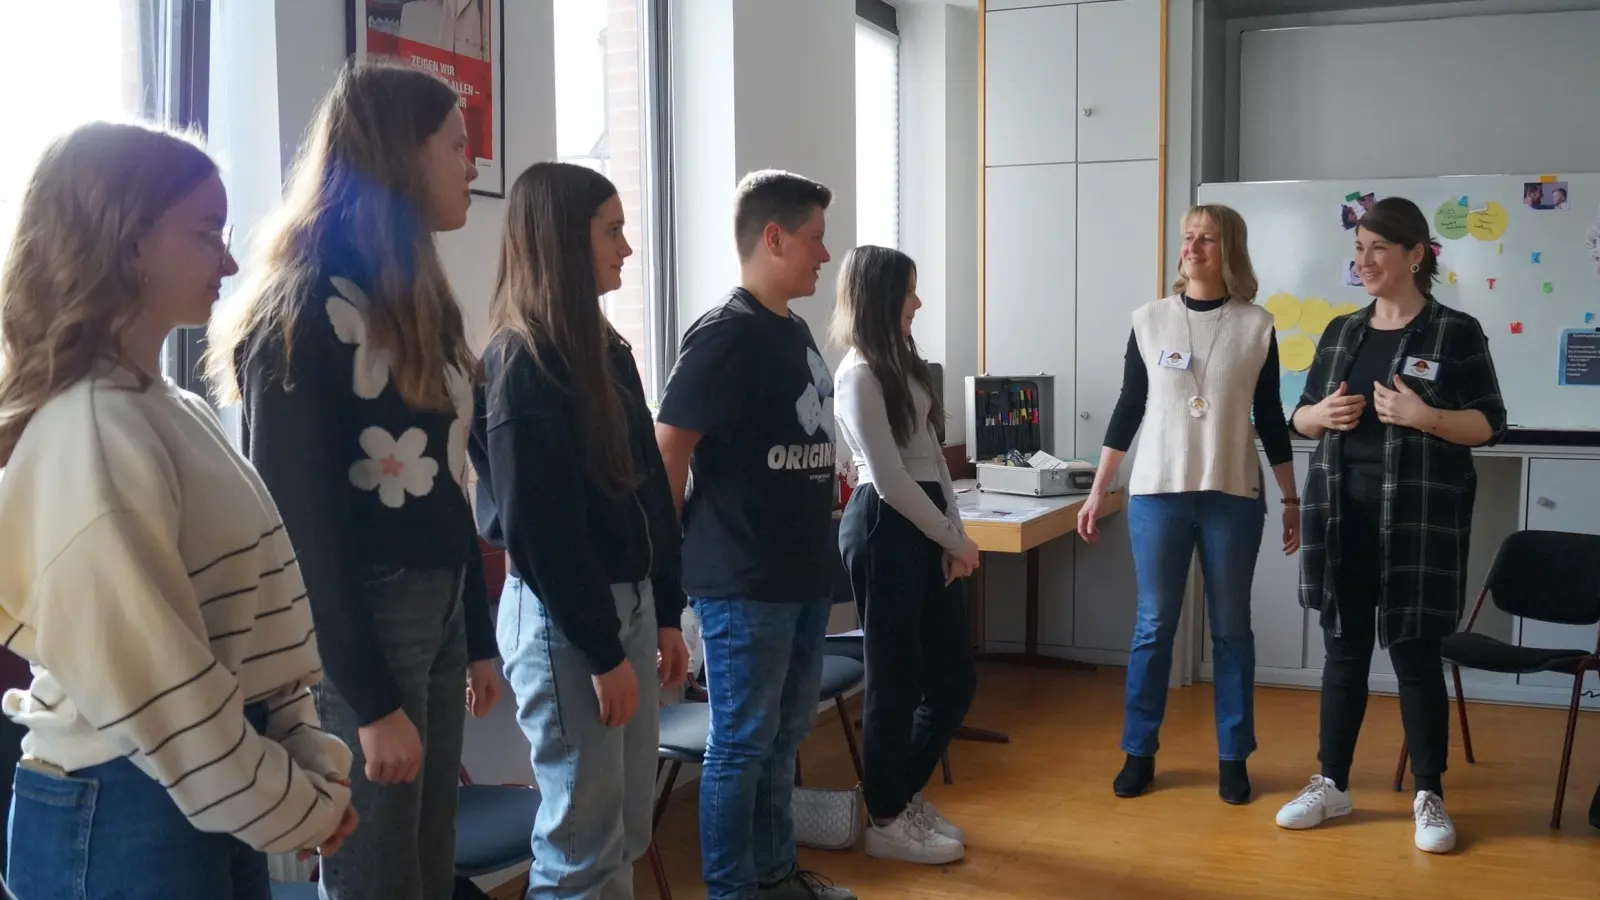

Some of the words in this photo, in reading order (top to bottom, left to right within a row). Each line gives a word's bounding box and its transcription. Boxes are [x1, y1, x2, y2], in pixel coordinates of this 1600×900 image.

[411, 55, 439, 72] ZEIGEN
[440, 62, 455, 77] WIR
[450, 80, 474, 96] ALLEN
[1486, 278, 1497, 290] T
